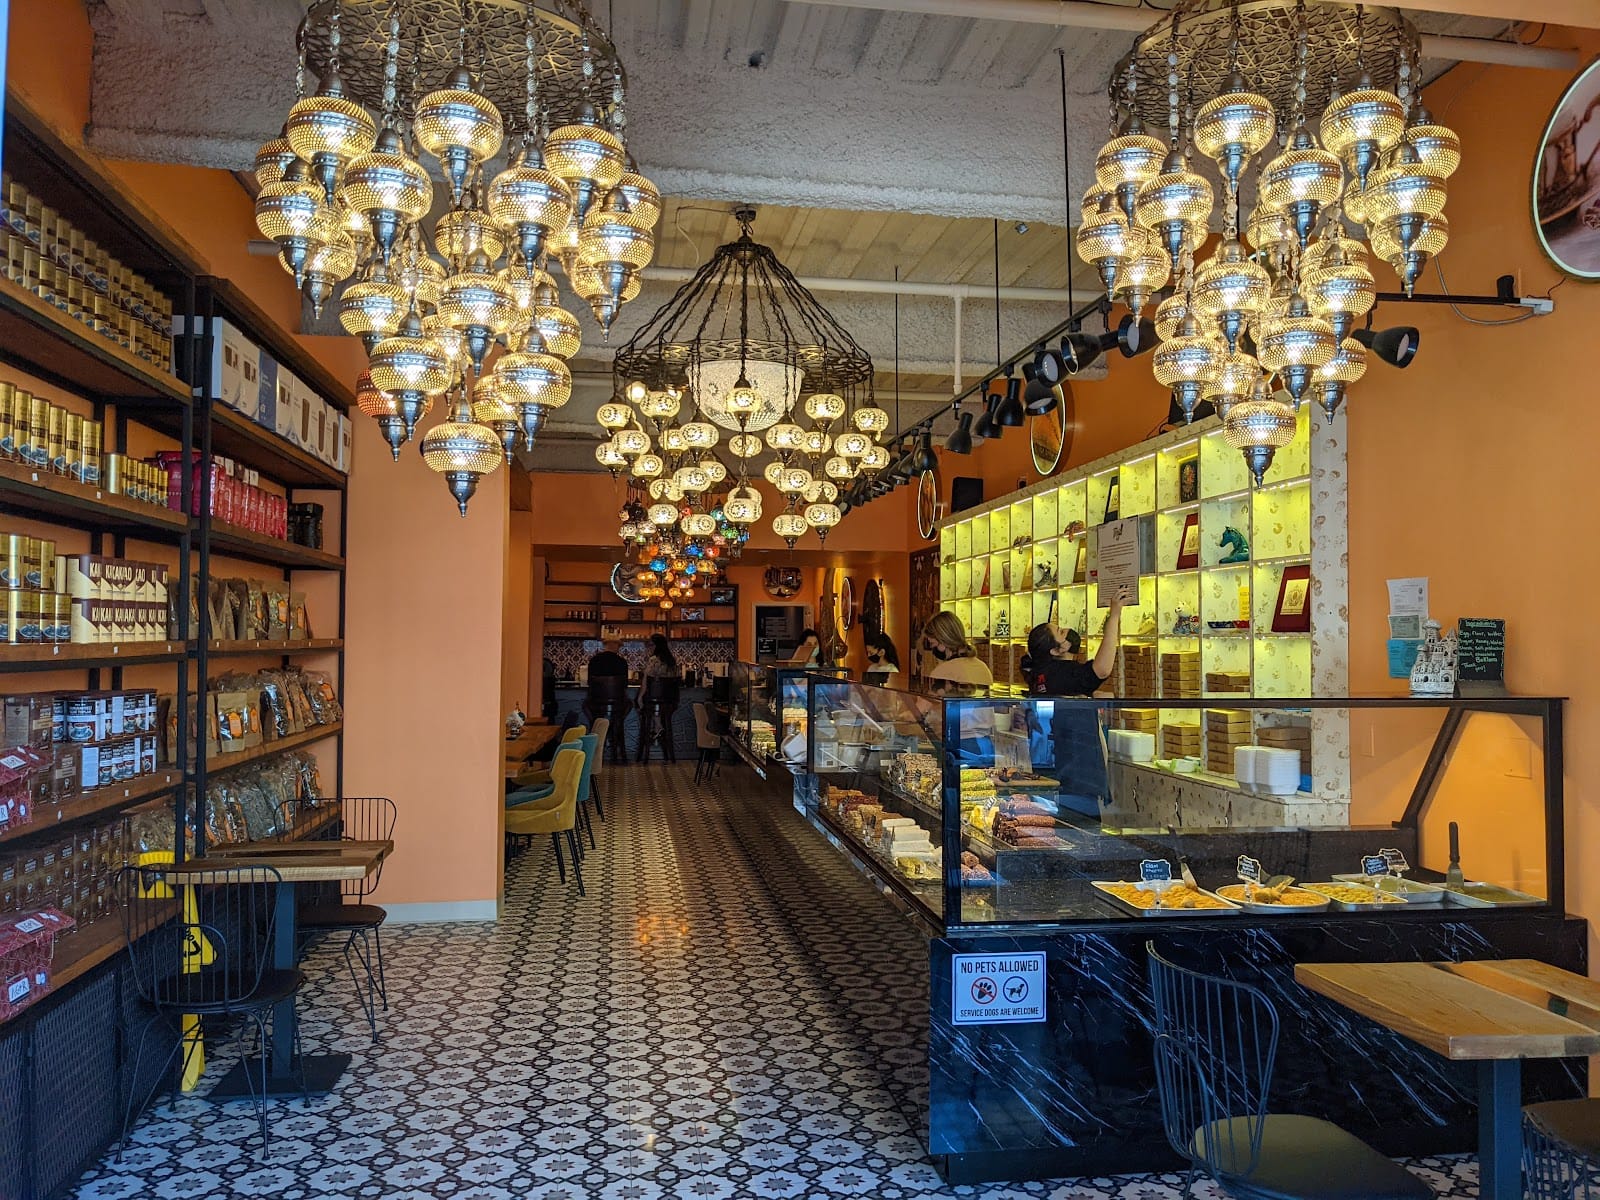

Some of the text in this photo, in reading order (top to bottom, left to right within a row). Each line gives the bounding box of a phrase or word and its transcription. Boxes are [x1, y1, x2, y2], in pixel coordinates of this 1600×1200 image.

[961, 960, 1039, 974] NO PETS ALLOWED
[960, 1006, 1039, 1017] SERVICE DOGS ARE WELCOME
